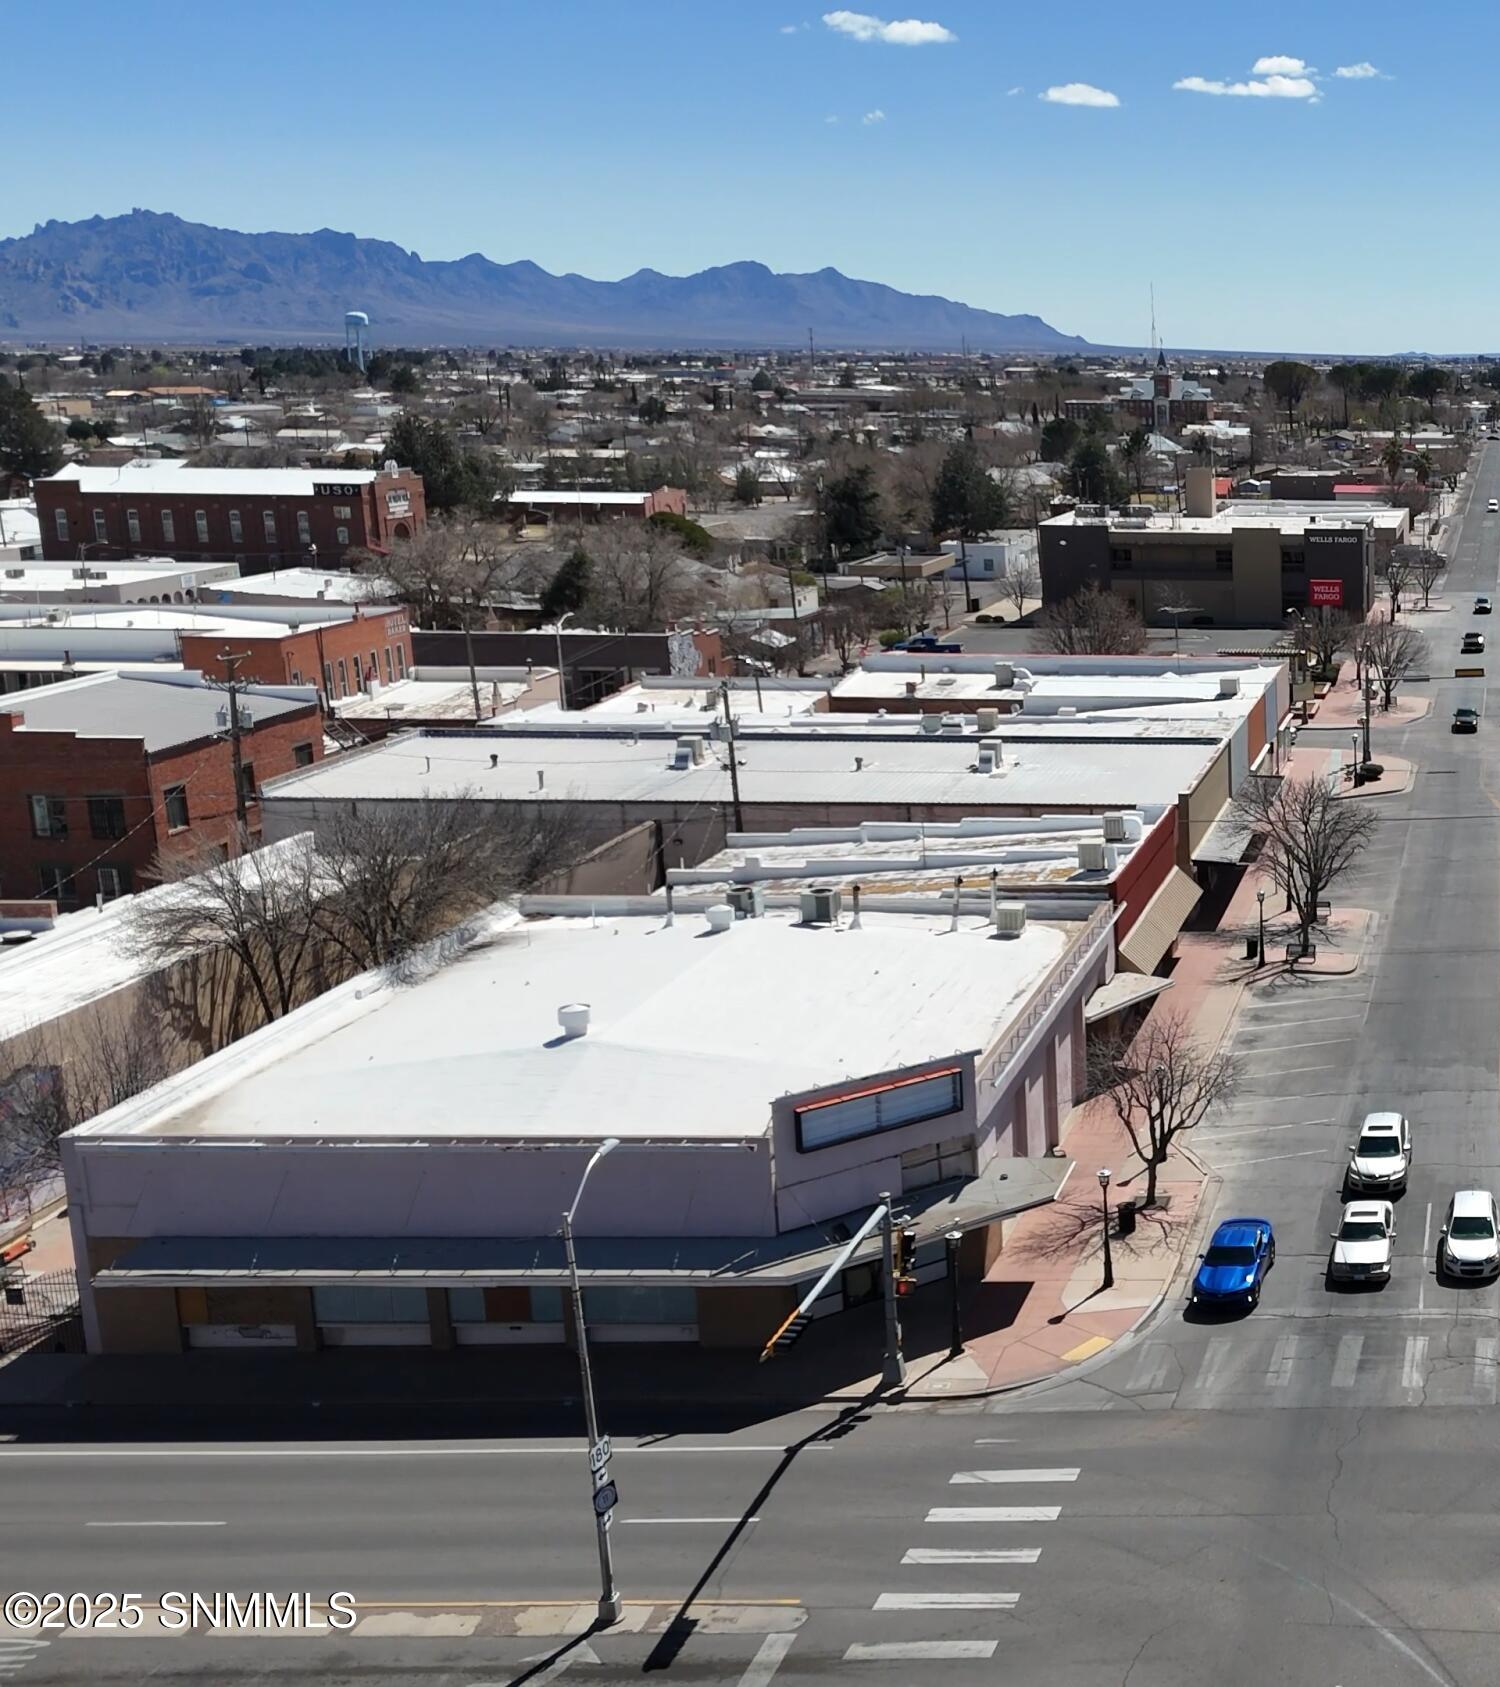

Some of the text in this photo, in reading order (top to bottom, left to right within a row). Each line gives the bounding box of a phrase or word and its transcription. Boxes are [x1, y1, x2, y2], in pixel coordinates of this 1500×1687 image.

[321, 488, 353, 496] USO
[1334, 536, 1358, 544] FARGO
[591, 1440, 610, 1468] 180
